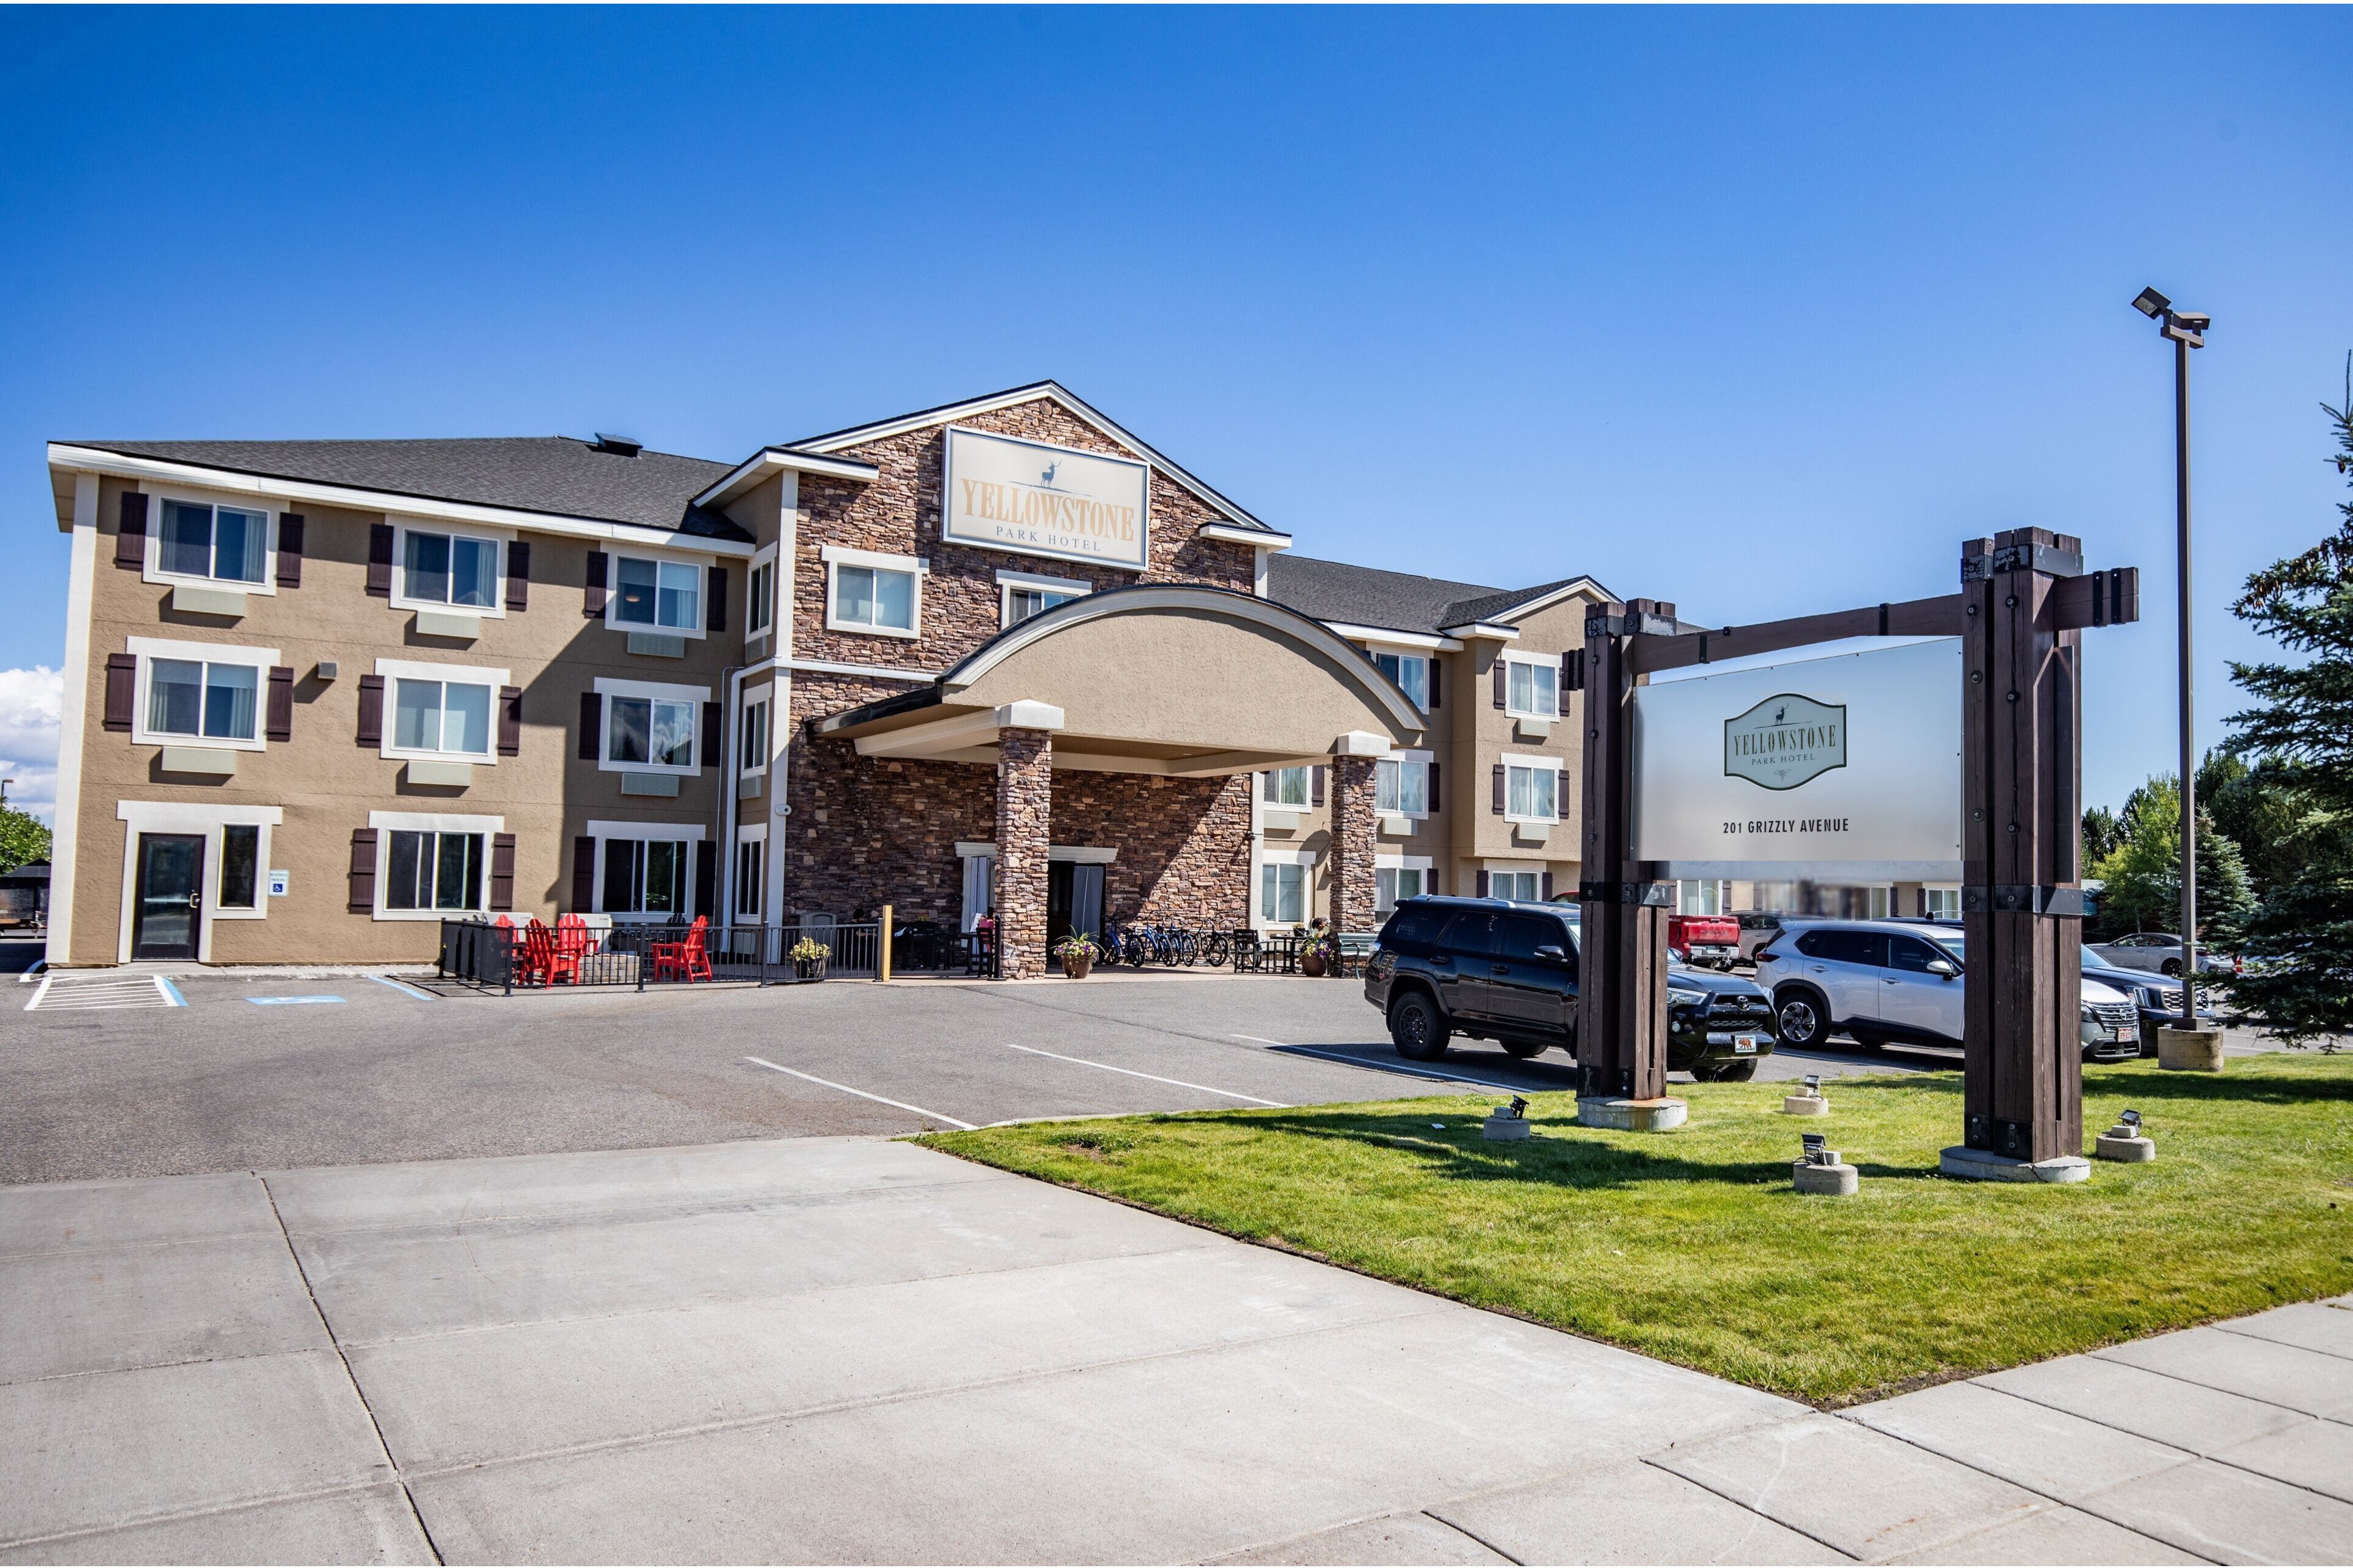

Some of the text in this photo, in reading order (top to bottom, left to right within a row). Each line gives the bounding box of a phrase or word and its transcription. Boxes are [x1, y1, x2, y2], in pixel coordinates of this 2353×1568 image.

[960, 478, 1134, 542] YELLOWSTONE
[996, 525, 1101, 551] PARK HOTEL
[1733, 724, 1836, 756] YELLOWSTONE
[1751, 754, 1816, 765] PARK HOTEL
[1723, 819, 1849, 833] 201 GRIZZLY AVENUE
